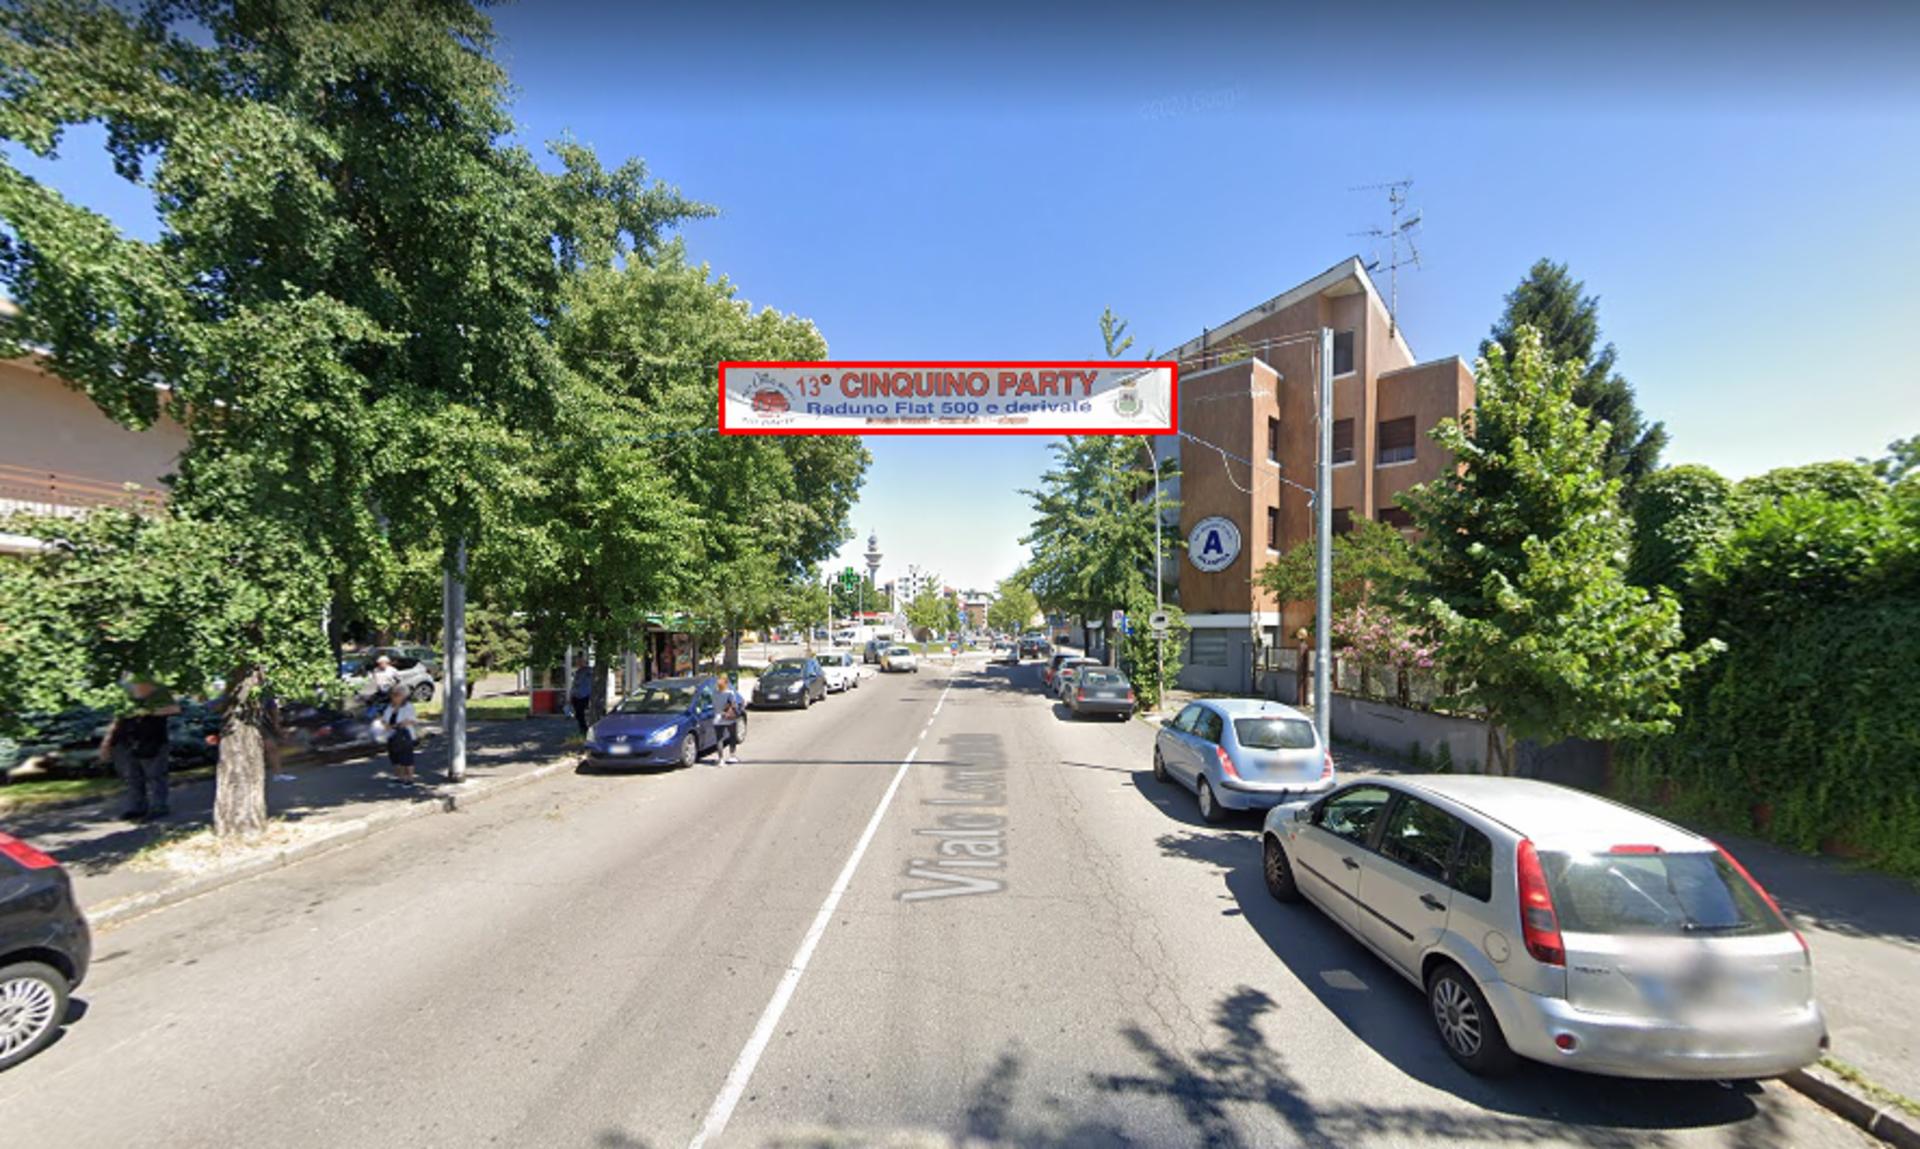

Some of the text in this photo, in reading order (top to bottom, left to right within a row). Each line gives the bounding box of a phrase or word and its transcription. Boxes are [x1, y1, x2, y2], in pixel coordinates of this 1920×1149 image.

[839, 371, 990, 398] CINQUINO
[998, 370, 1099, 397] PARTY
[806, 402, 888, 415] Raduno
[895, 402, 935, 414] Fiat
[941, 402, 979, 414] 500
[986, 403, 999, 414] e
[1203, 529, 1223, 555] A
